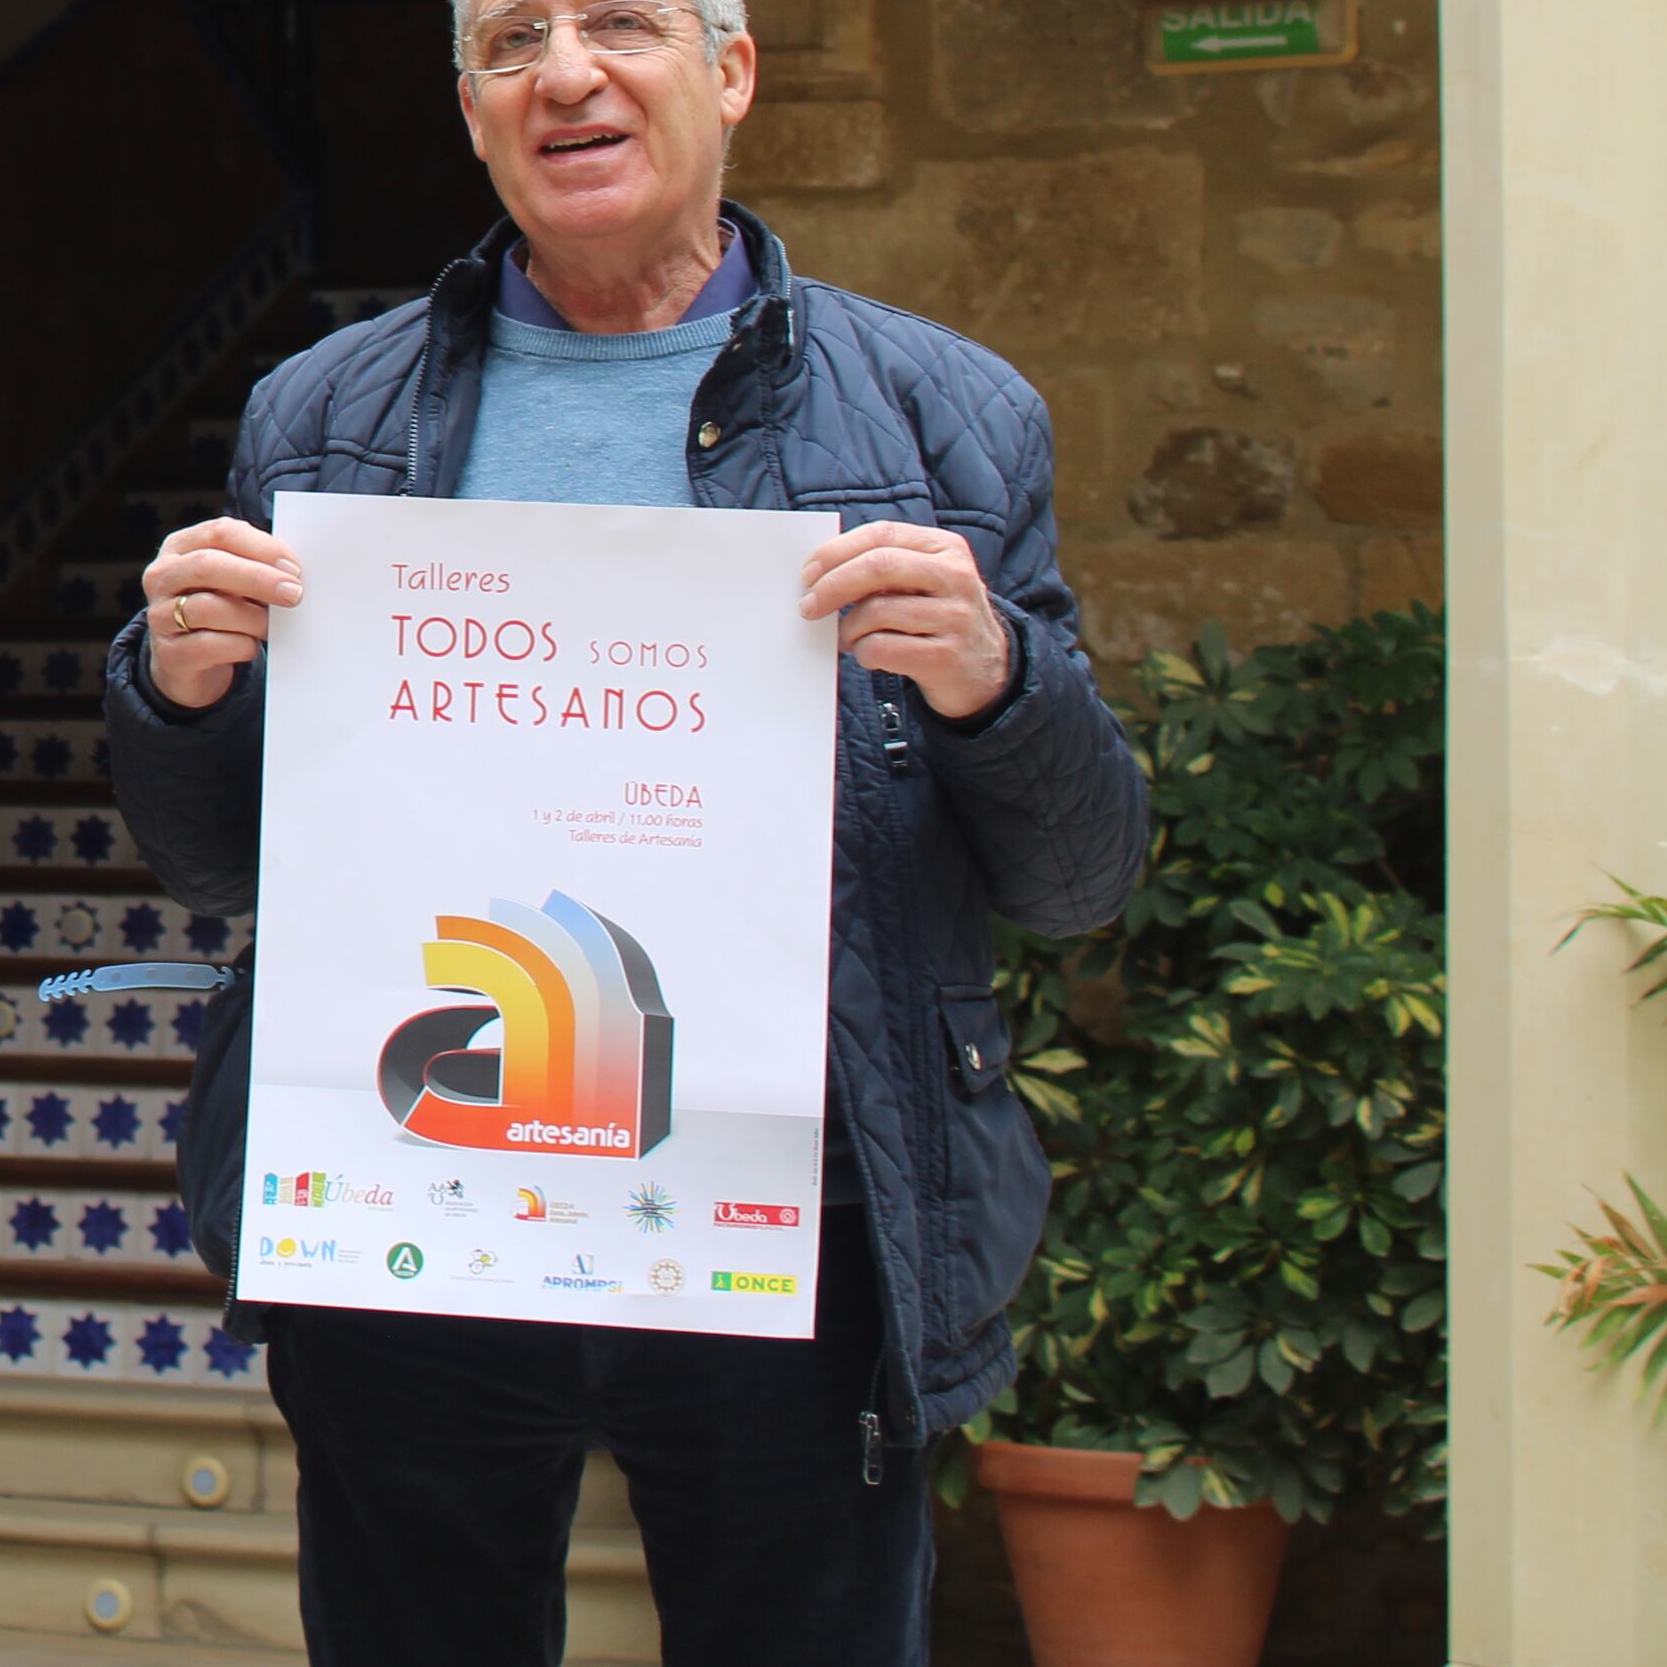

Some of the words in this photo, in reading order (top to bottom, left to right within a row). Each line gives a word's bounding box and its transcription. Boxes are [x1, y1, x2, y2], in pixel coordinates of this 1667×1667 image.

[1162, 0, 1310, 31] SALIDA
[391, 562, 511, 593] Talleres
[391, 615, 557, 662] TODOS
[590, 640, 707, 668] SOMOS
[389, 679, 705, 733] ARTESANOS
[543, 812, 551, 825] y
[555, 810, 563, 822] 2
[566, 810, 583, 823] de
[585, 811, 616, 824] abril
[568, 829, 616, 844] Talleres
[619, 832, 636, 845] de
[506, 1119, 631, 1149] artesanía
[324, 1174, 394, 1206] Úbeda
[736, 1277, 792, 1293] ONCE
